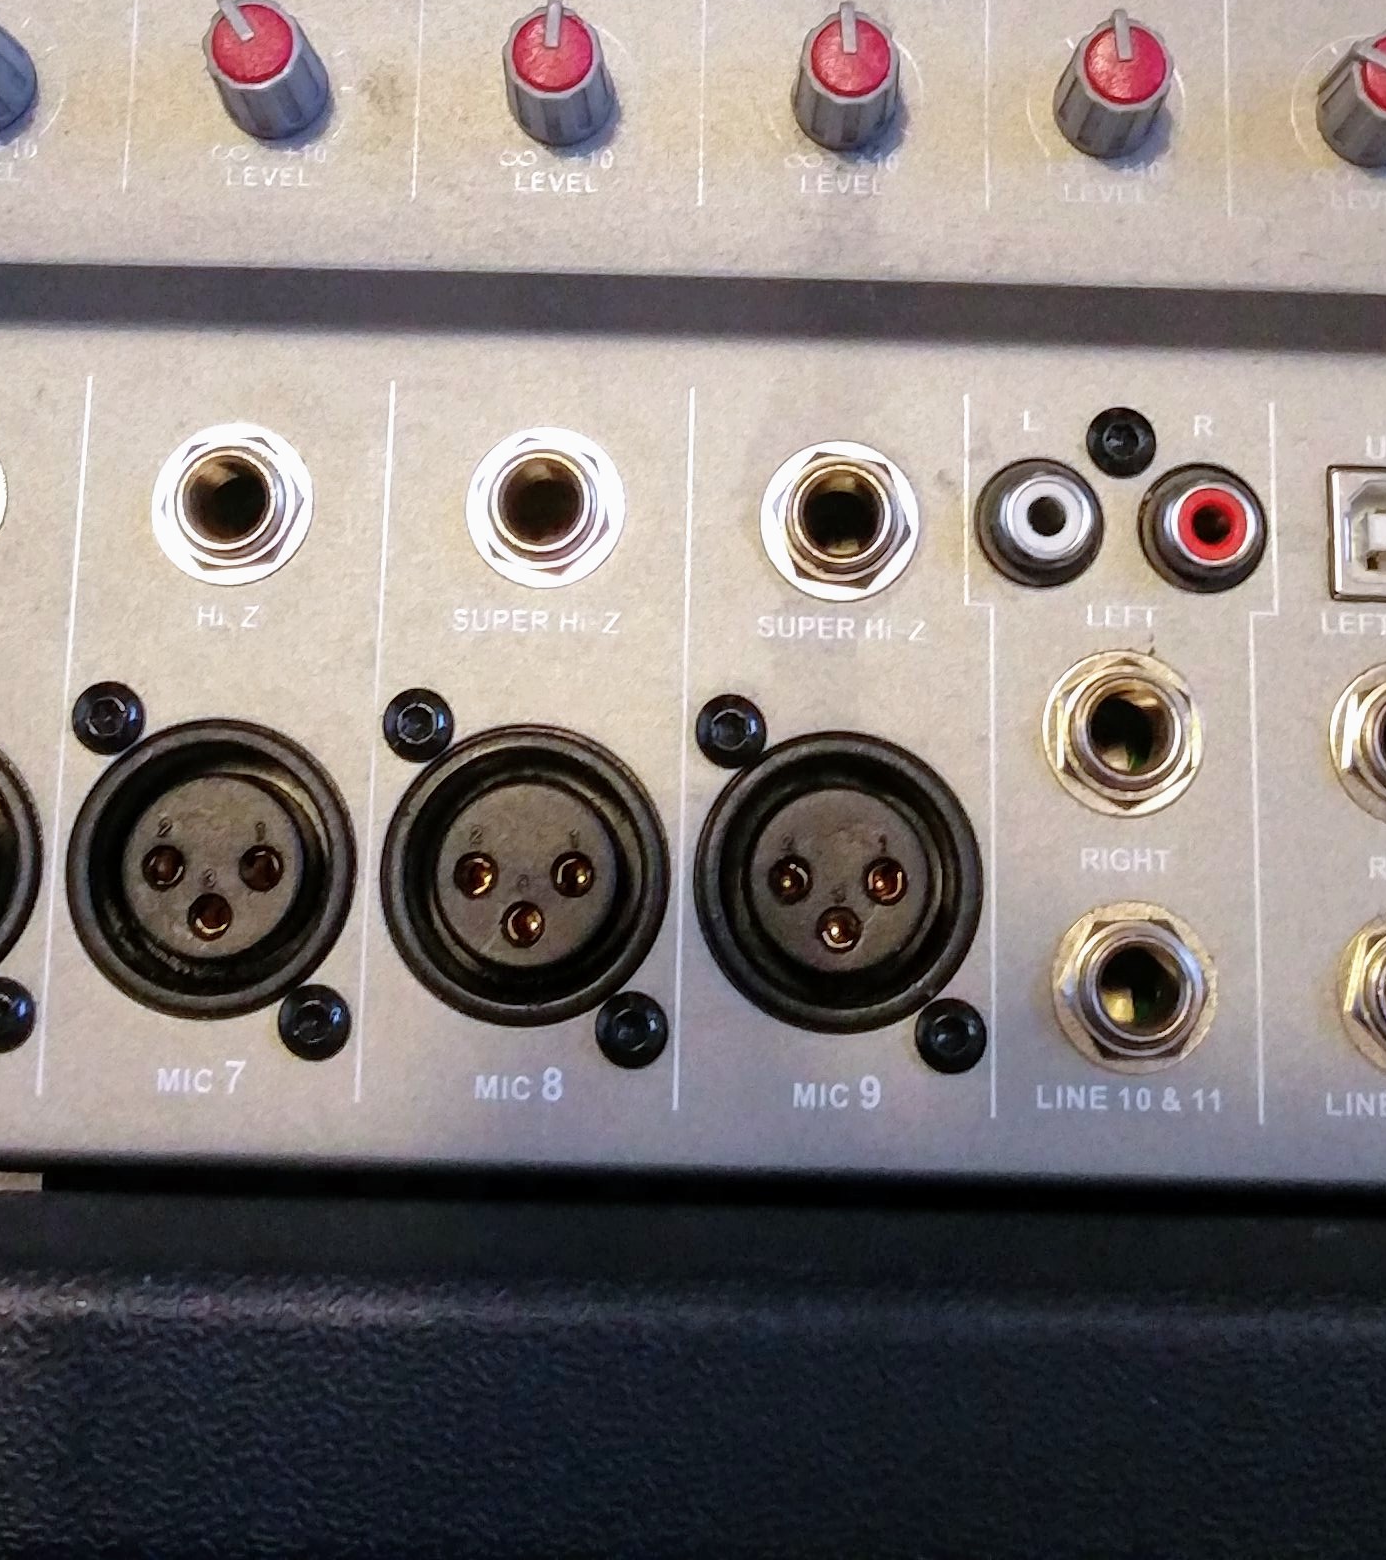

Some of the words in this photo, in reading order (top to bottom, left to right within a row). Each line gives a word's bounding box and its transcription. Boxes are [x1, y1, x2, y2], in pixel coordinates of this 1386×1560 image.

[226, 167, 309, 186] LEVEL
[515, 172, 599, 192] LEVEL
[1023, 412, 1037, 431] L
[1196, 414, 1213, 438] R
[453, 609, 547, 631] SUPER
[758, 616, 855, 639] SUPER
[1087, 605, 1154, 628] LEFT
[1080, 848, 1170, 873] RIGHT
[157, 1067, 213, 1094] MIC
[224, 1060, 246, 1094] 7
[475, 1074, 532, 1101] MIC
[541, 1067, 564, 1102] 8
[793, 1082, 849, 1109] MIC
[858, 1084, 880, 1110] 9
[1036, 1087, 1109, 1112] LINE
[1118, 1088, 1154, 1112] 10
[1162, 1088, 1182, 1112] &
[1189, 1088, 1222, 1112] 11
